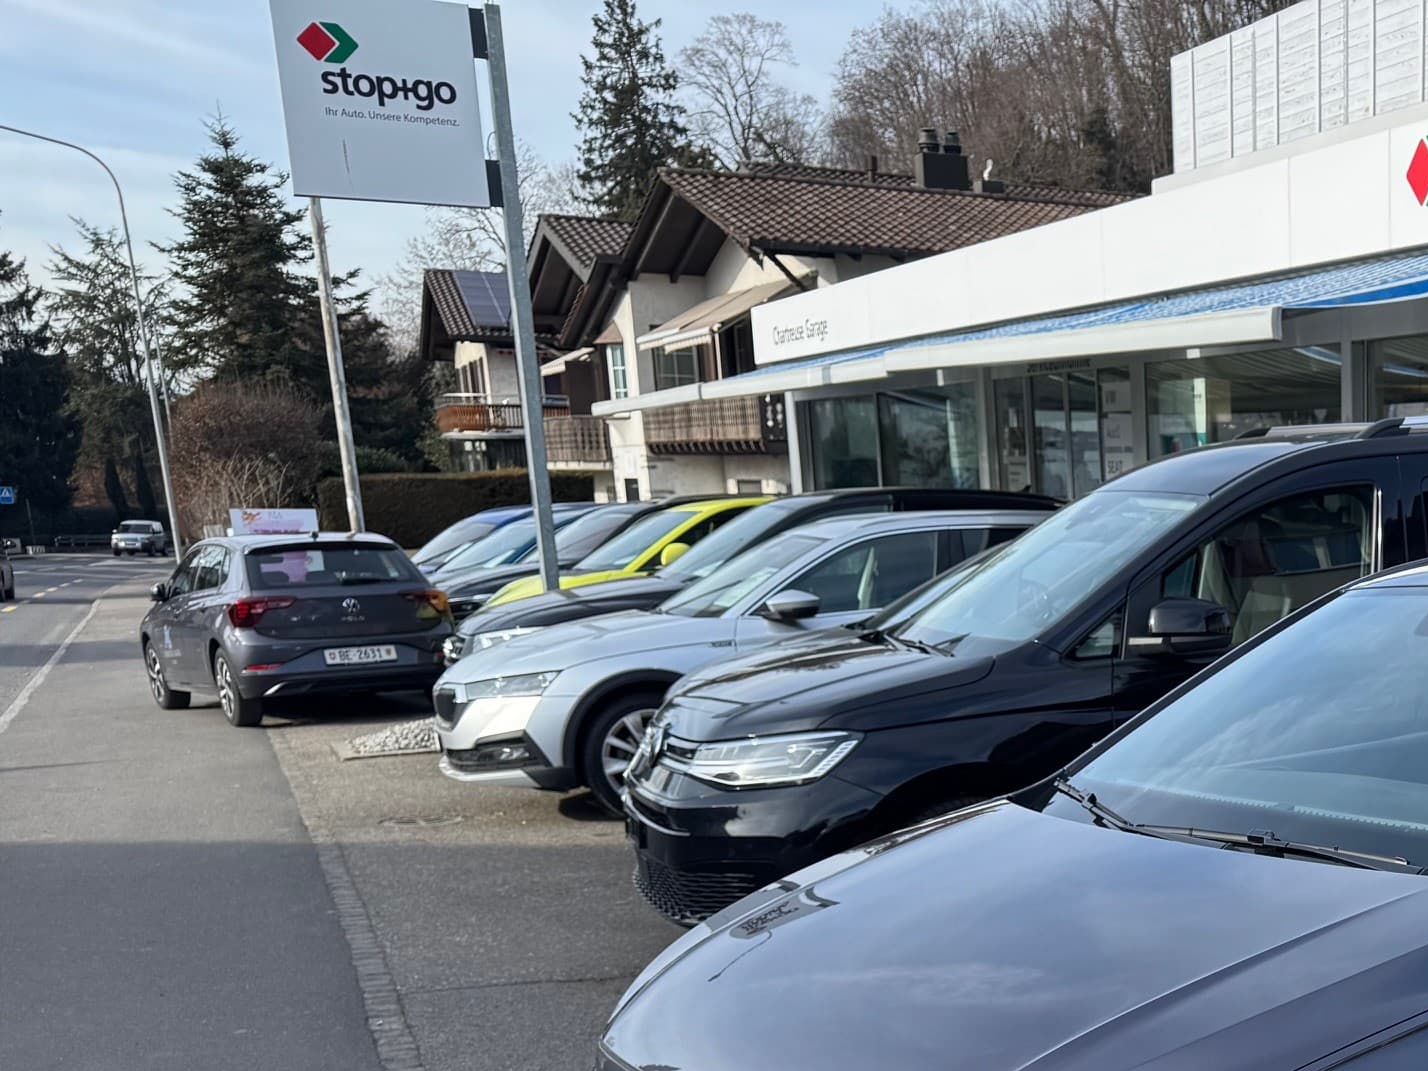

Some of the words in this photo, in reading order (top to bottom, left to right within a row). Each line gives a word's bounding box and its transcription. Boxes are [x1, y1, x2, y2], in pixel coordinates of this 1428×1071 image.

[321, 67, 457, 111] stop+go
[325, 106, 338, 117] Ihr
[341, 108, 367, 119] Auto.
[368, 110, 402, 122] Unsere
[403, 113, 460, 127] Kompetenz.
[460, 134, 582, 206] stop+go
